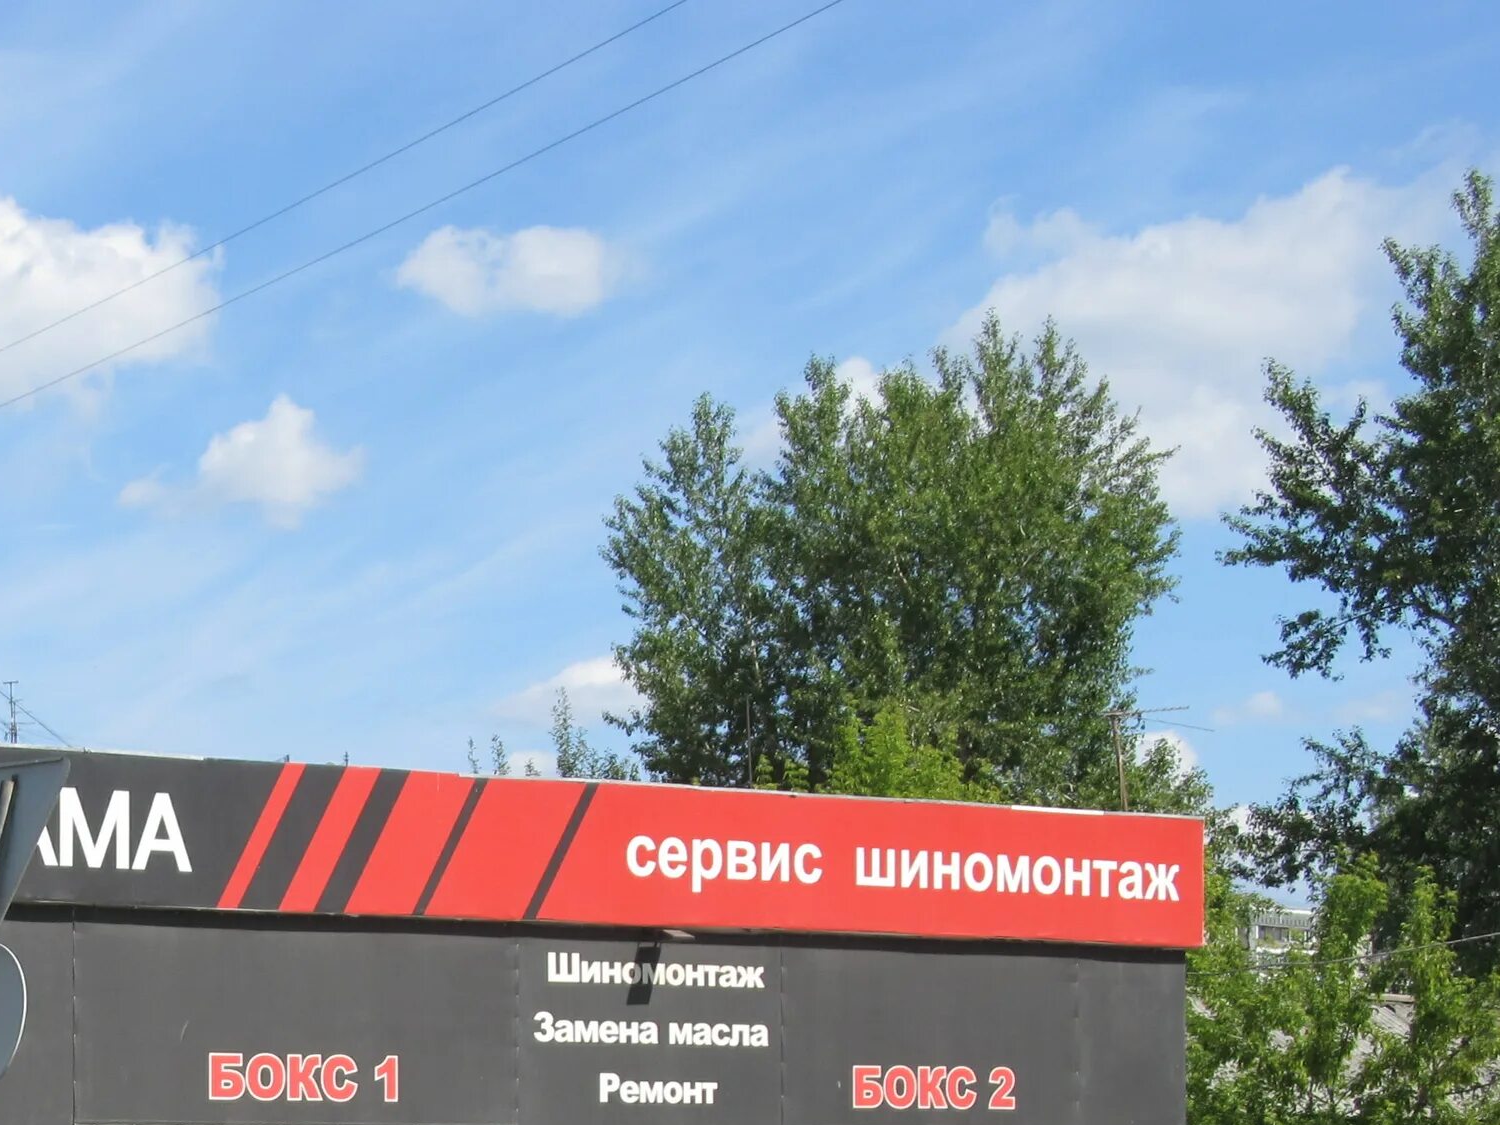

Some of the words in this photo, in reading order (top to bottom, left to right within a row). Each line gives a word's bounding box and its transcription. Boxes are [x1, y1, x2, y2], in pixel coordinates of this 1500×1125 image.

[625, 833, 824, 892] сервис
[855, 845, 1181, 902] шиномонтаж
[546, 950, 765, 990] Шиномонтаж
[533, 1011, 659, 1046] Замена
[668, 1018, 769, 1048] масла
[208, 1052, 359, 1102] БОКС
[373, 1055, 400, 1103] 1
[598, 1072, 718, 1106] Ремонт
[851, 1064, 978, 1111] БОКС
[987, 1066, 1017, 1111] 2
